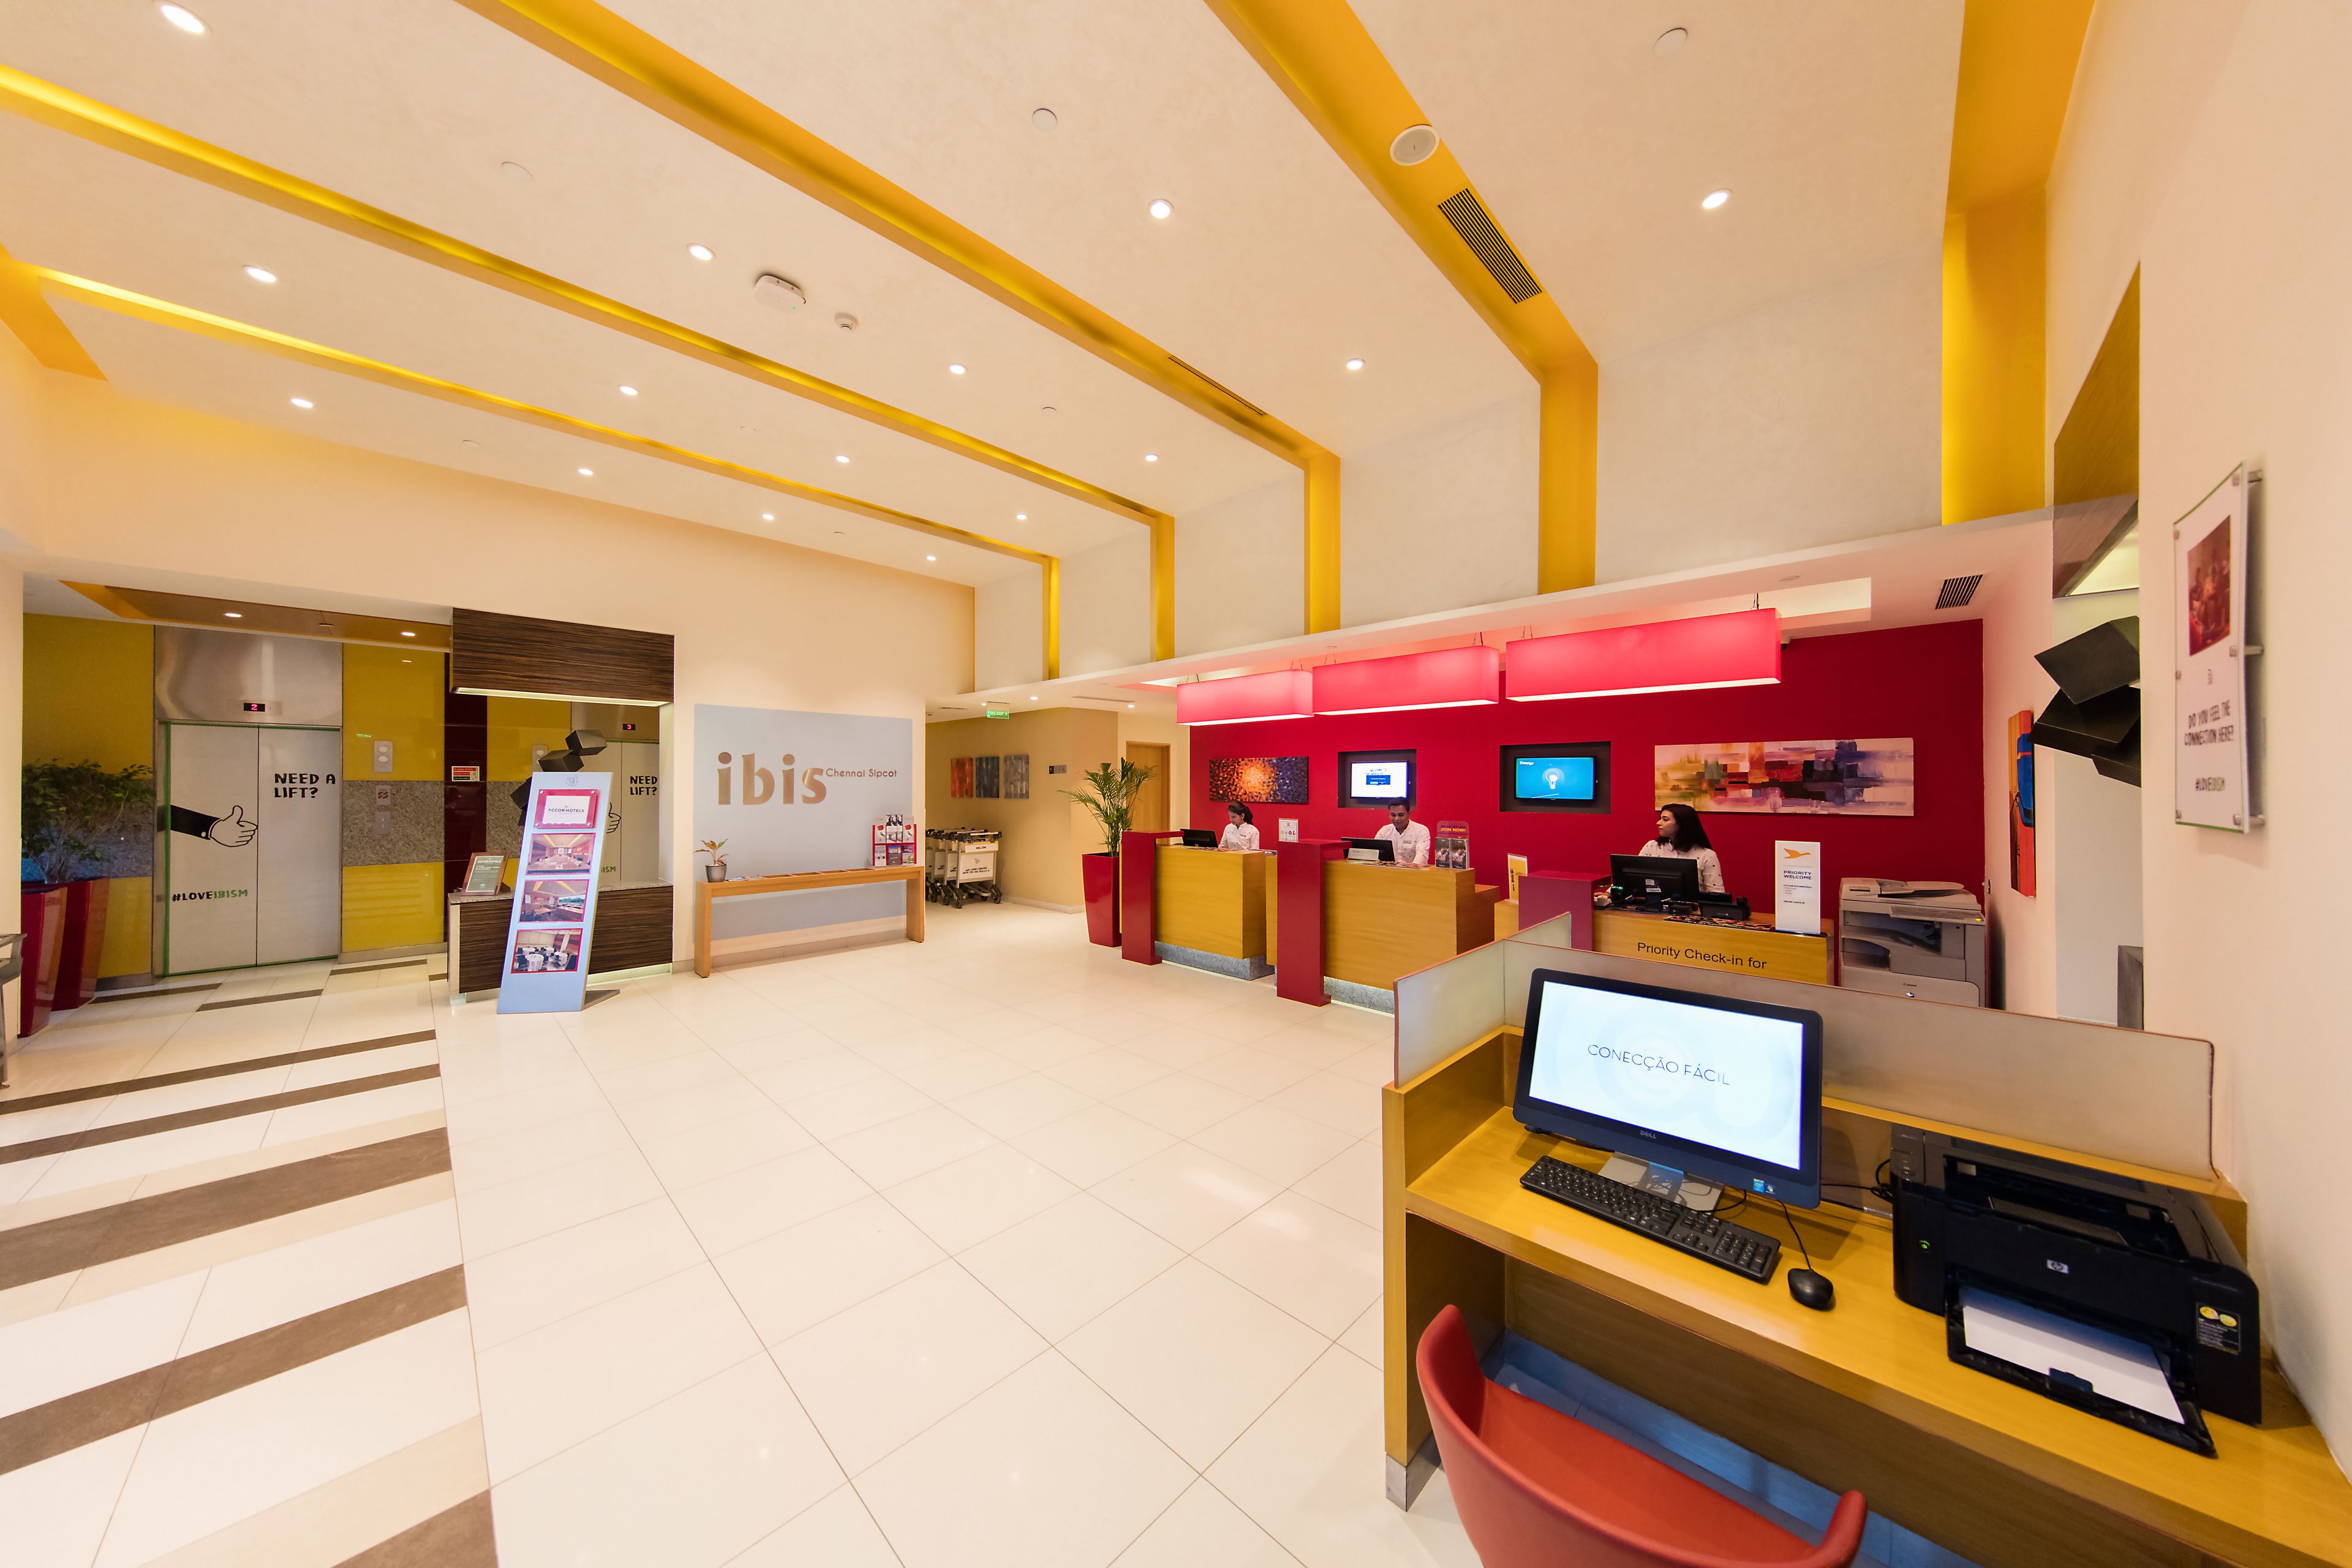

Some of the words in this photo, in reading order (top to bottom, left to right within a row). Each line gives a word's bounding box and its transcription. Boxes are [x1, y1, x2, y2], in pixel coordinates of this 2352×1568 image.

[2209, 704, 2220, 722] FEEL
[2222, 699, 2230, 718] THE
[274, 773, 319, 785] NEED
[326, 774, 336, 785] A
[630, 775, 658, 785] NEED
[717, 752, 827, 805] ibis
[826, 768, 865, 777] Chennai
[869, 769, 897, 778] Sipcot
[274, 787, 318, 798] LIFT?
[630, 786, 657, 796] LIFT?
[172, 889, 248, 902] #LOVEIBISM
[1638, 942, 1680, 959] Priority
[1684, 949, 1743, 966] Check-in
[1748, 957, 1767, 969] for
[1588, 1044, 1679, 1073] CONECÇÃO
[1684, 1063, 1730, 1085] FÁCIL
[1640, 1130, 1657, 1139] DELL
